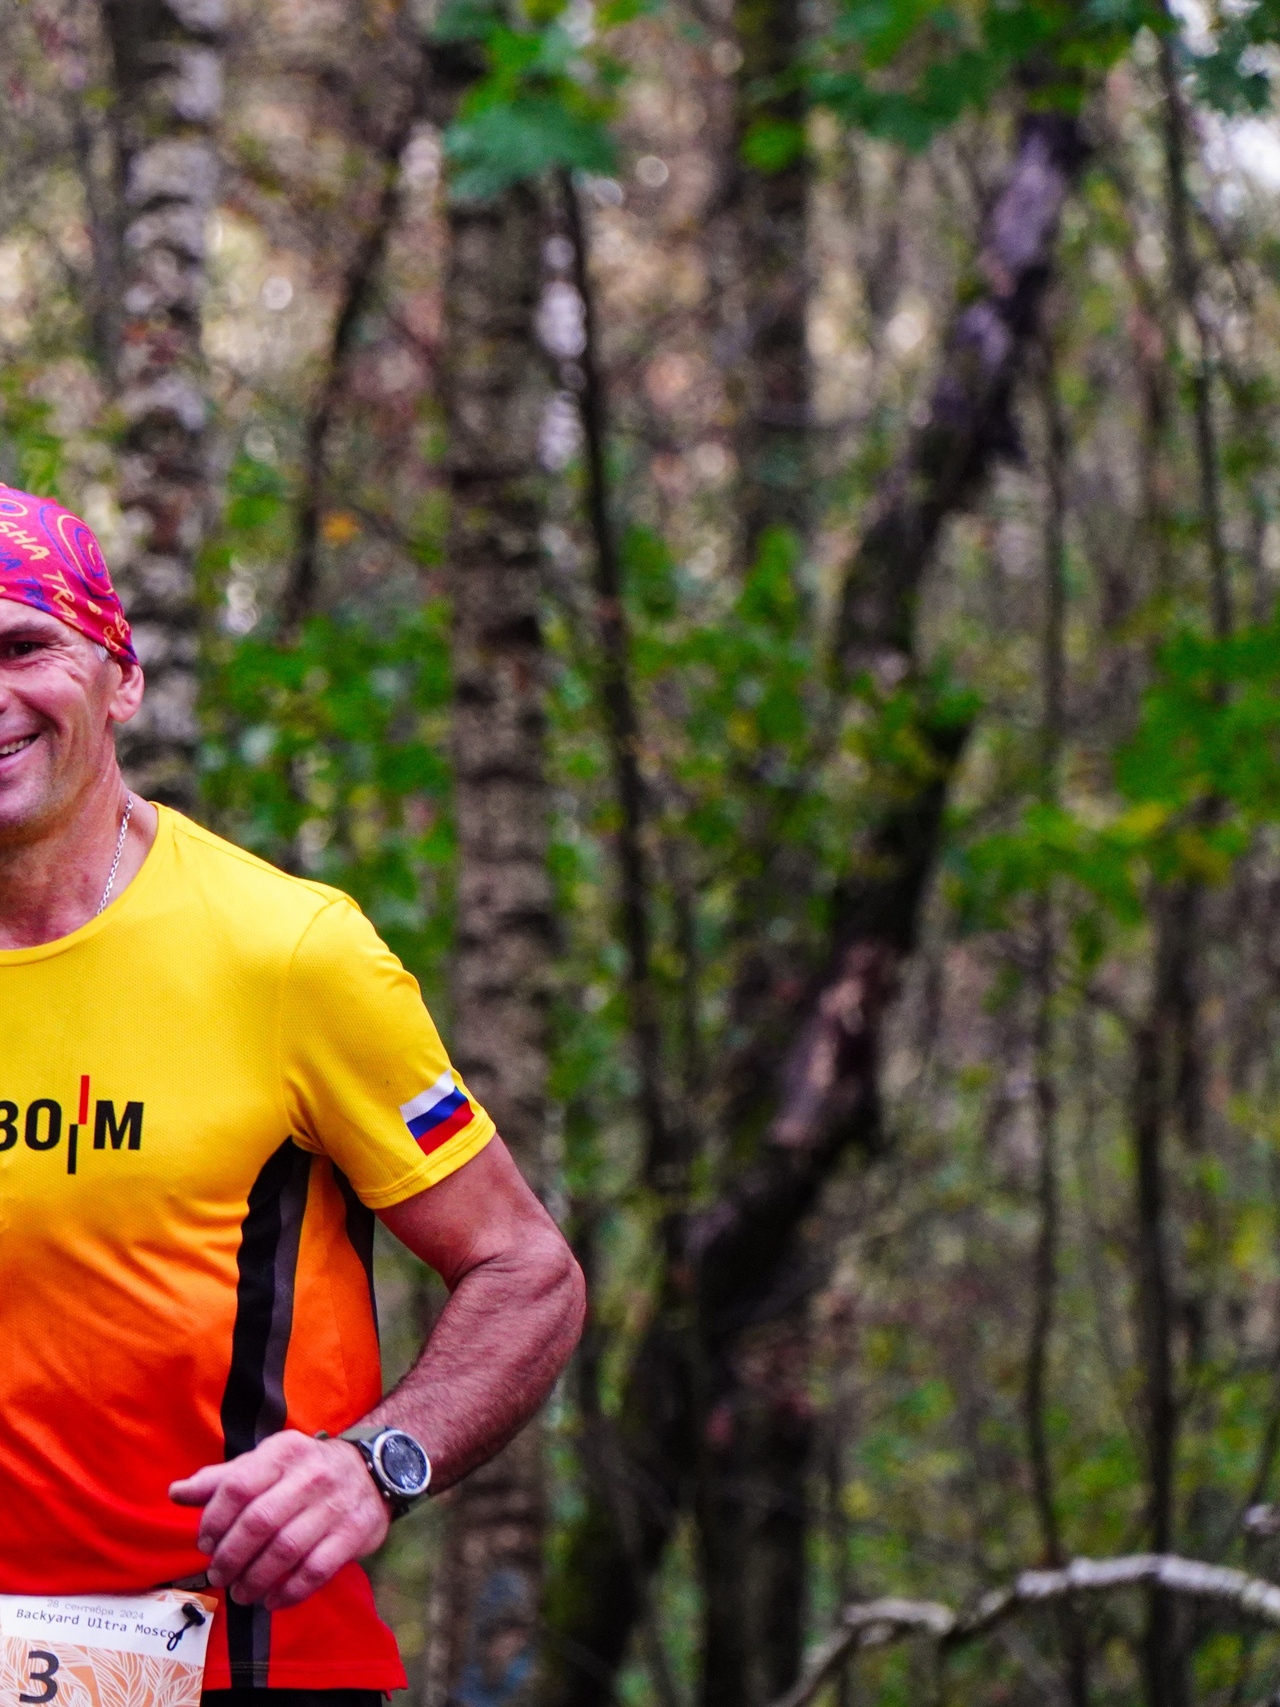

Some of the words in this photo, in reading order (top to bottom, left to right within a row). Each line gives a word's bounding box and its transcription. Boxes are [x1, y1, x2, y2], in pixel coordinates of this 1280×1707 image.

[16, 1608, 80, 1625] Backyard
[87, 1616, 127, 1632] Ultra
[46, 1599, 60, 1608] 28
[64, 1602, 114, 1617] сентября
[120, 1609, 144, 1620] 2024
[19, 1650, 60, 1704] 3
